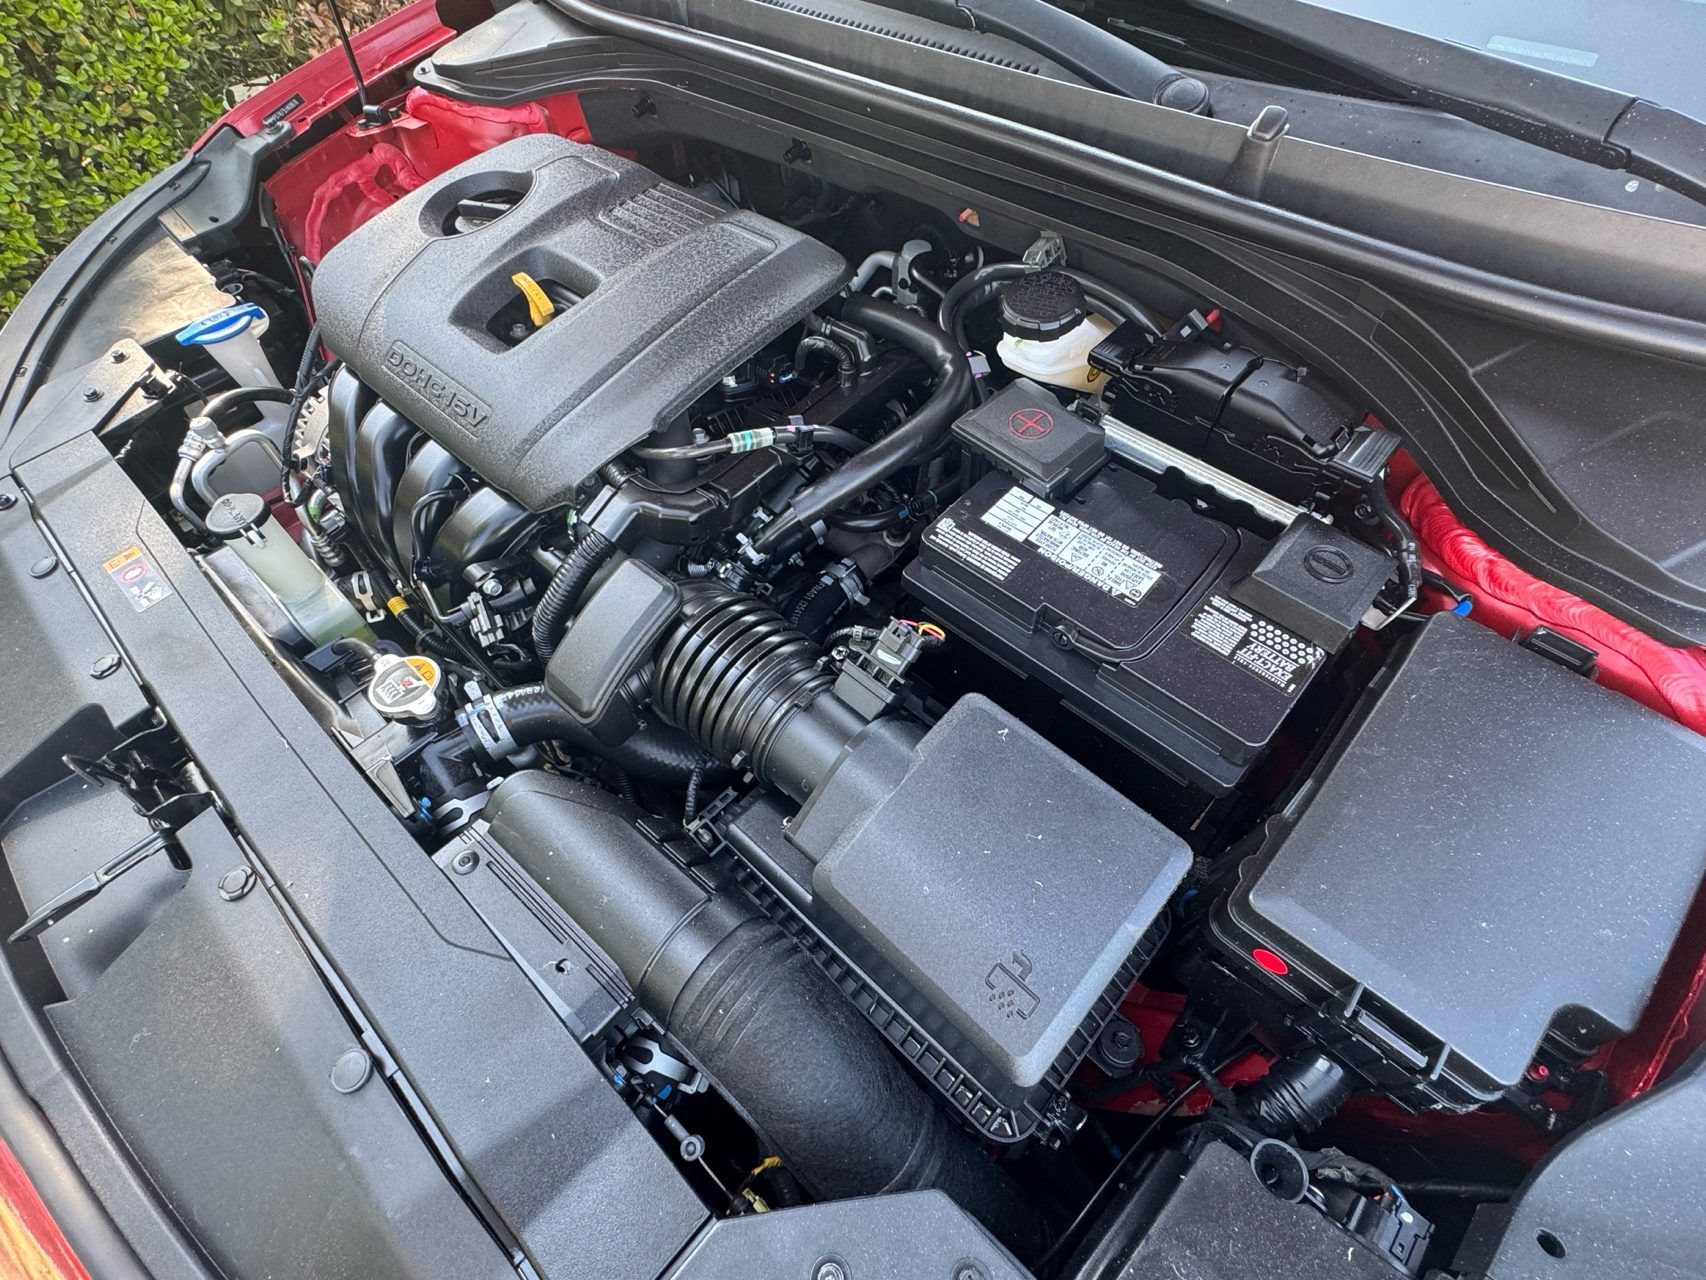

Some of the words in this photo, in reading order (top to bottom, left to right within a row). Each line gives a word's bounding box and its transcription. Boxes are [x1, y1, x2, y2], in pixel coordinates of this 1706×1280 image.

[386, 346, 446, 398] DOHC
[447, 392, 488, 428] 16V
[1037, 547, 1111, 590] DANGER/POISON
[1235, 647, 1294, 682] EXACT-FIT
[1246, 642, 1296, 673] BATTERY
